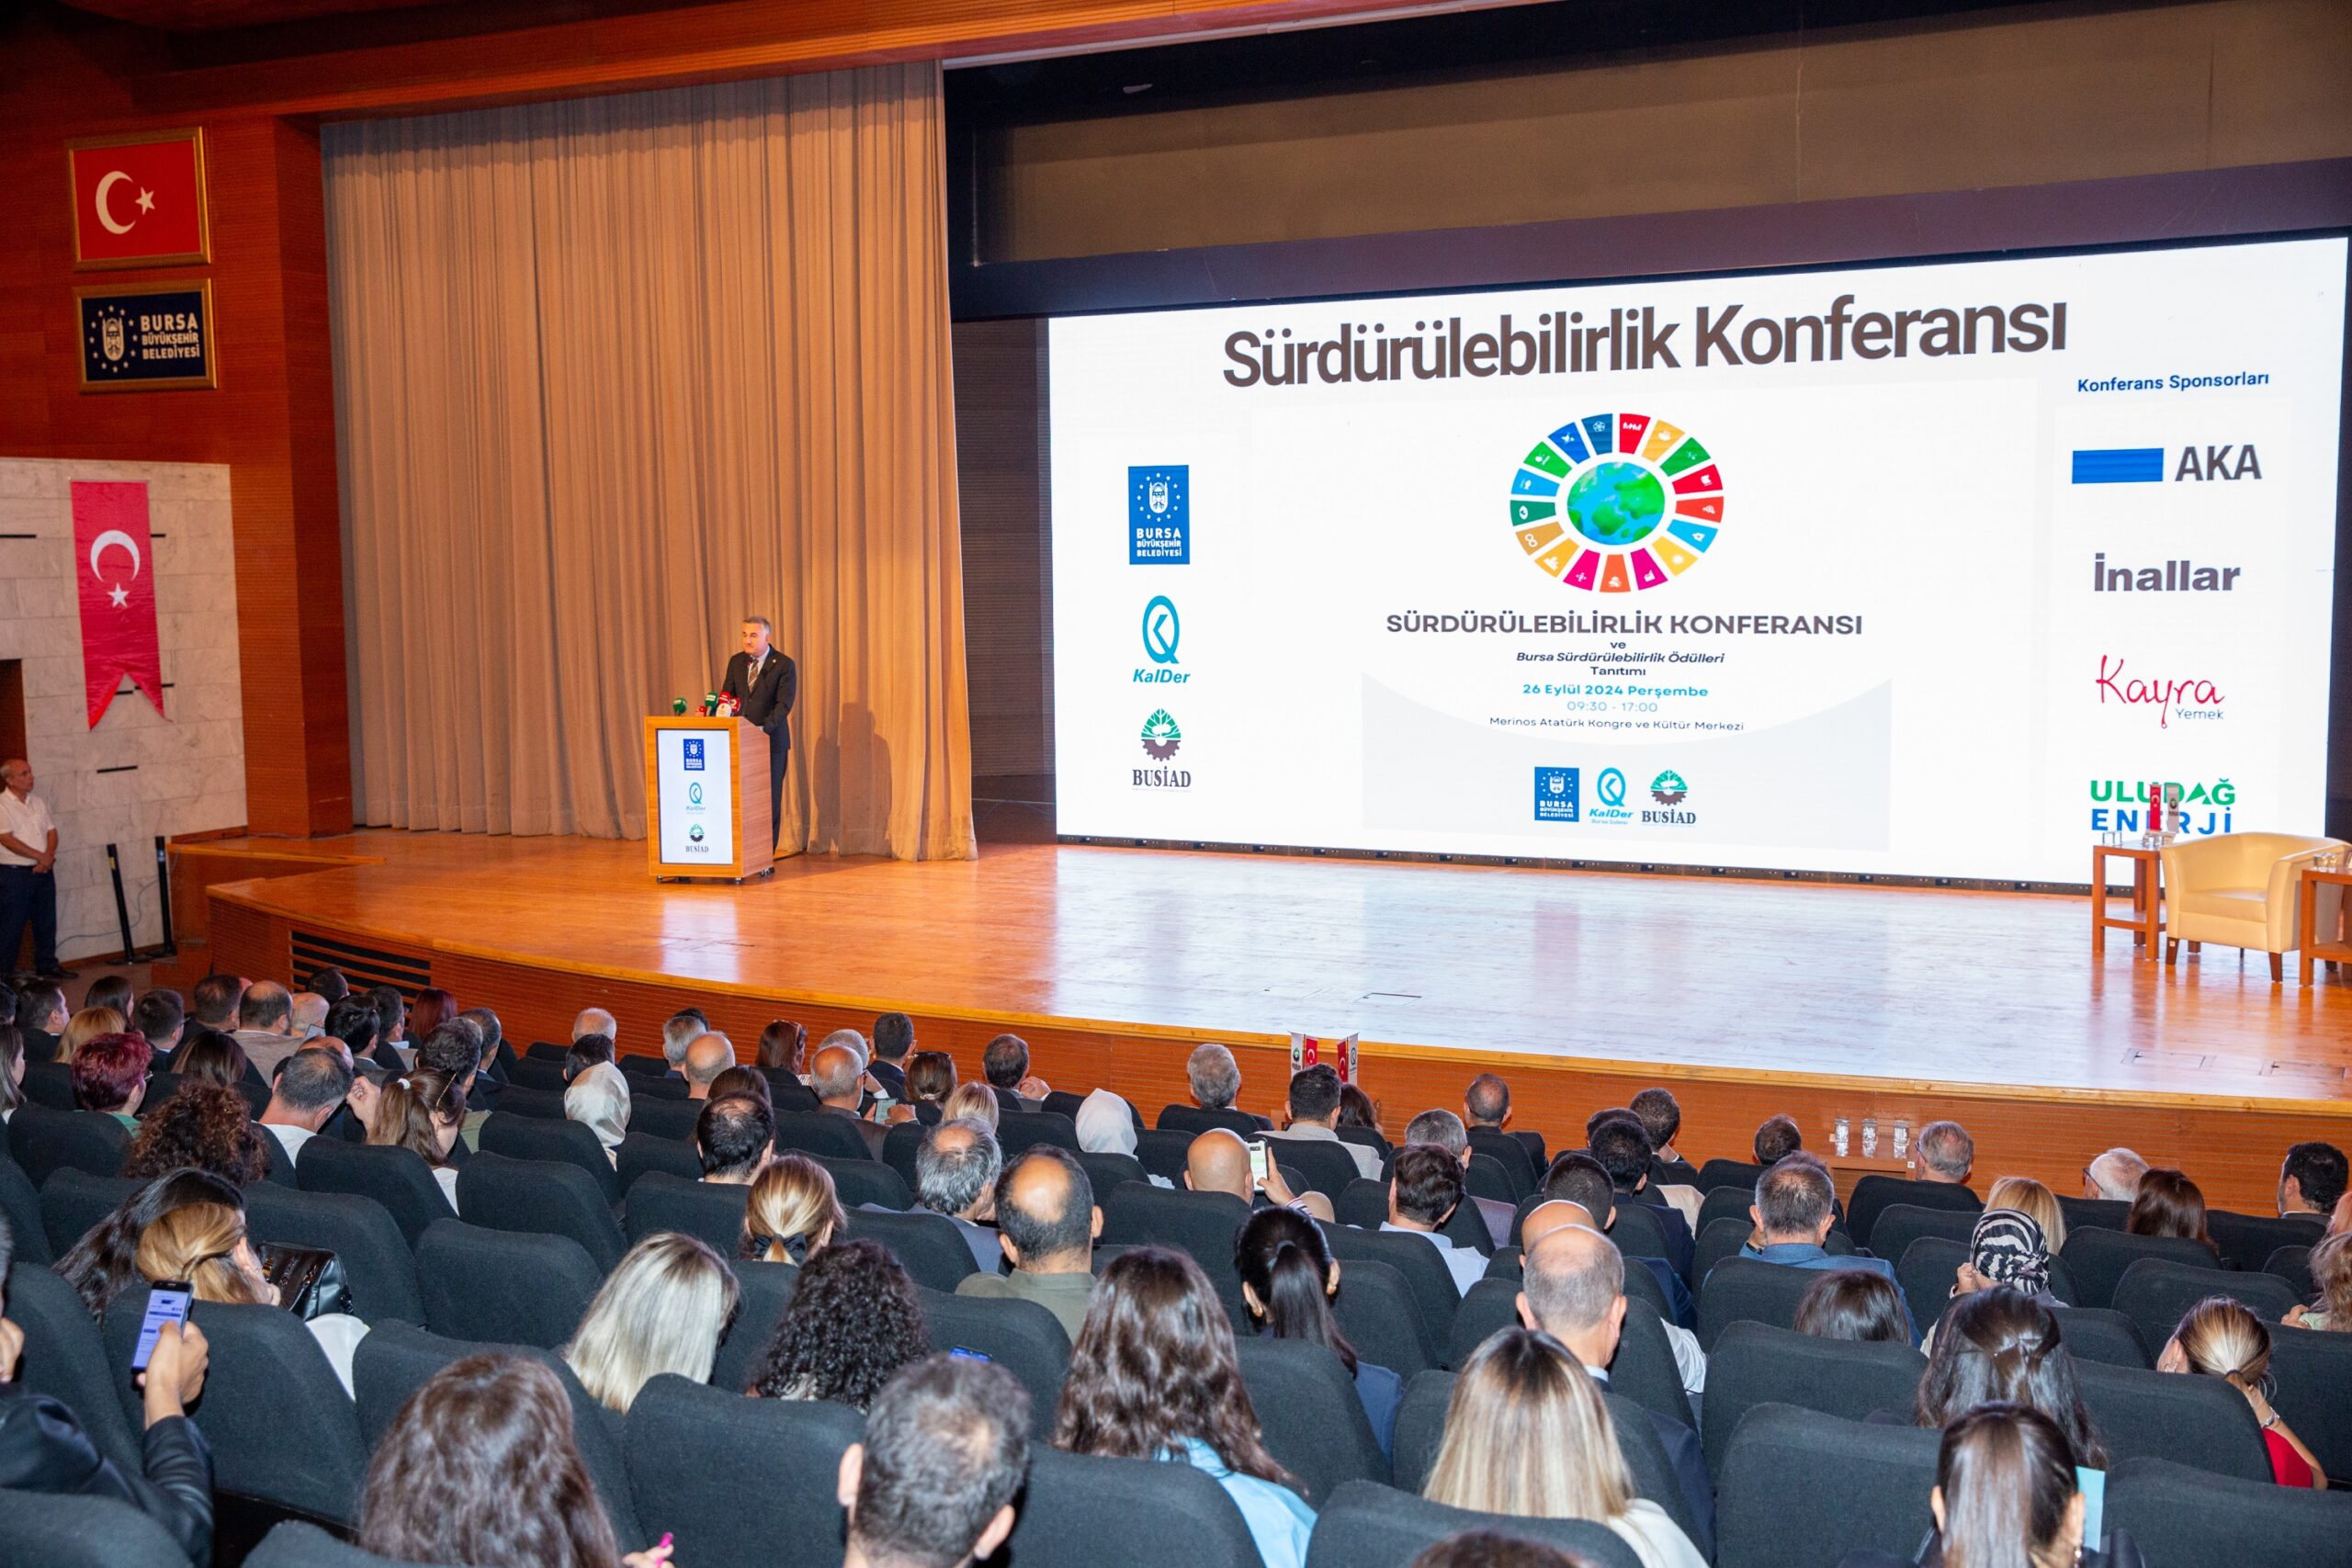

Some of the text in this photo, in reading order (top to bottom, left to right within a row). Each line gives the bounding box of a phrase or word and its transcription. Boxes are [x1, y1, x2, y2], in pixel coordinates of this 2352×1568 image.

[141, 312, 198, 332] BURSA
[1224, 294, 2067, 388] Sürdürülebilirlik Konferansı
[142, 344, 200, 360] BELEDİYESİ
[2077, 371, 2269, 392] Konferans Sponsorları
[2174, 444, 2263, 482] AKA
[1136, 527, 1182, 539] BURSA
[1136, 547, 1182, 558] BELEDİYESİ
[2094, 552, 2242, 592] İnallar
[1386, 609, 1862, 636] SÜRDÜRÜLEBİLİRLİK KONFERANSI
[1610, 641, 1627, 649] ve
[1516, 650, 1725, 663] Bursa Sürdürülebilirlik Ödülleri
[1132, 668, 1192, 684] KalDer
[1589, 666, 1646, 676] Tanıtımı
[1522, 683, 1709, 699] 26 Eylül 2024 Perşembe
[2095, 654, 2225, 729] Kayra
[1566, 700, 1608, 712] 09:30
[1621, 701, 1658, 713] 17:00
[2174, 708, 2225, 721] Yemek
[1489, 716, 1537, 727] Merinos
[1539, 717, 1585, 728] Atatürk
[1588, 719, 1633, 730] Kongre
[1653, 720, 1691, 729] Kültür
[1694, 721, 1744, 731] Merkezi
[1132, 765, 1192, 788] BUSİAD
[1539, 800, 1573, 808] BURSA
[1589, 808, 1634, 818] KalDer
[1641, 808, 1697, 824] BUSİAD
